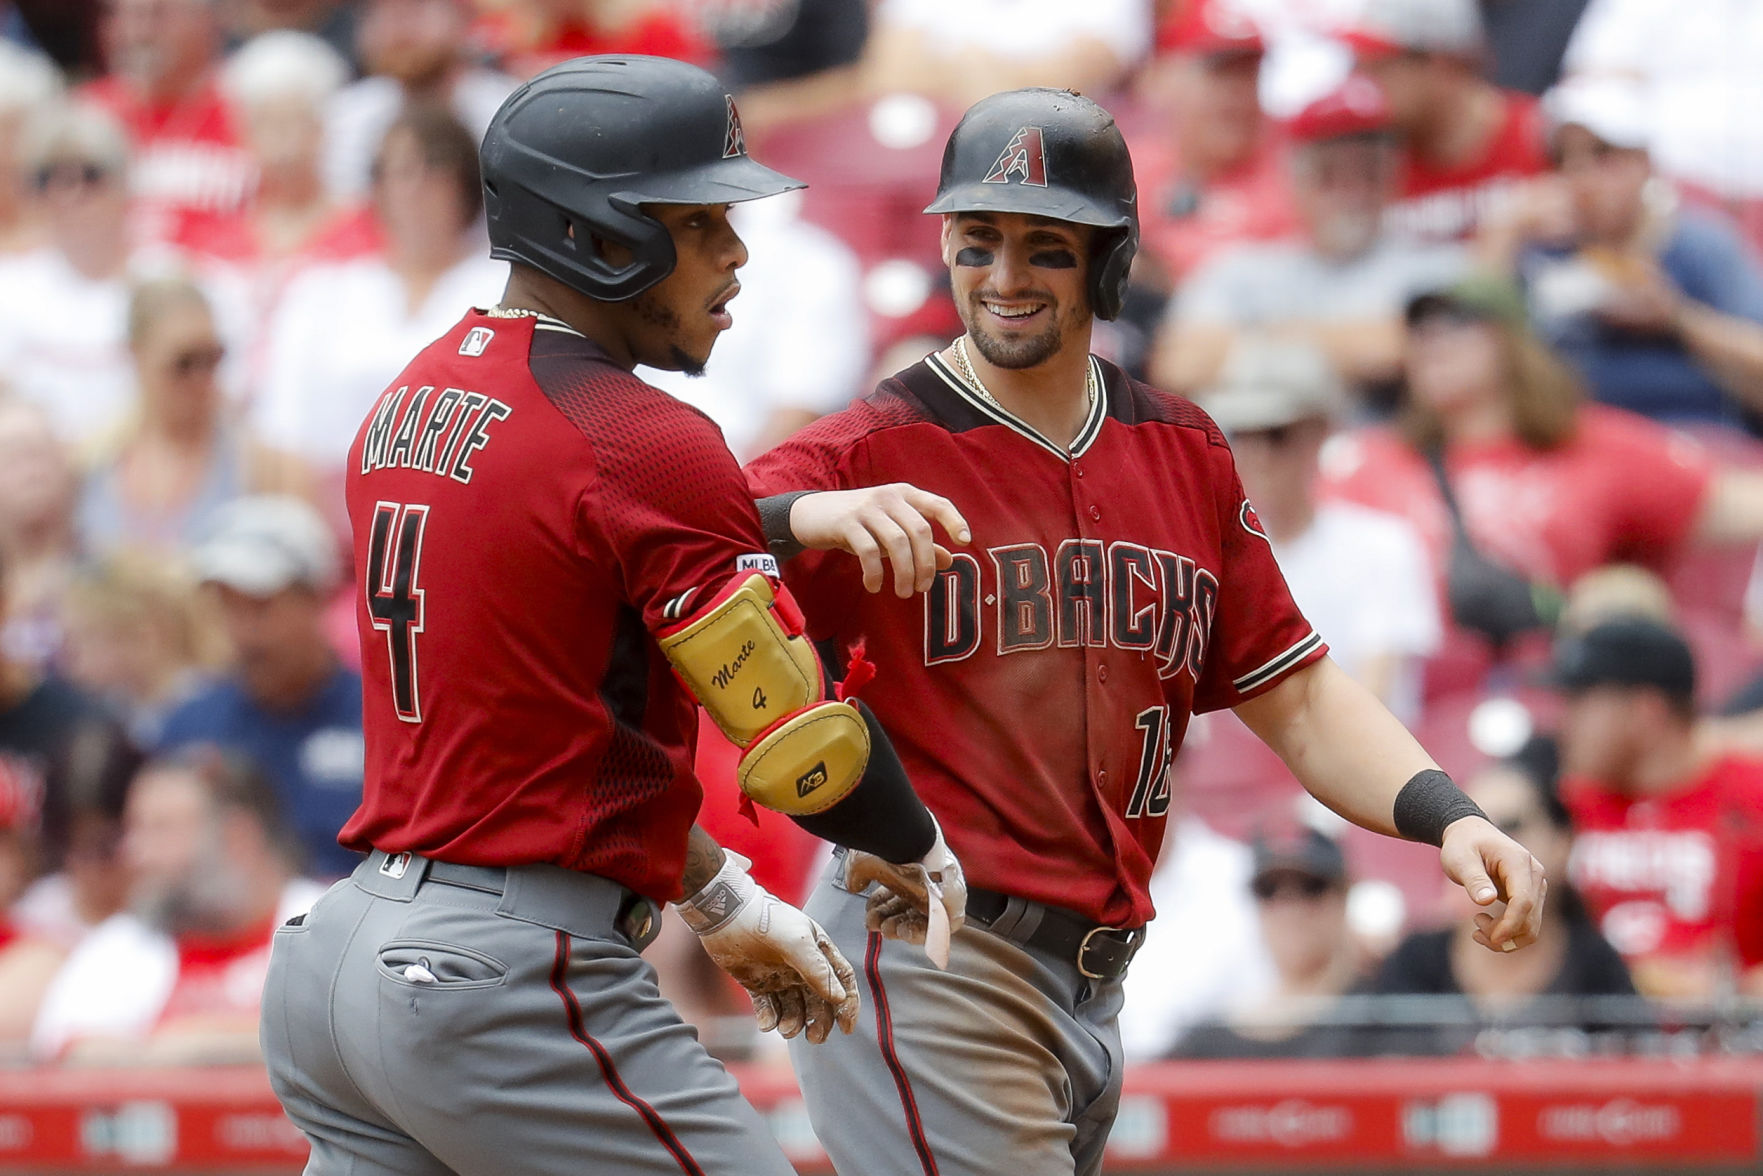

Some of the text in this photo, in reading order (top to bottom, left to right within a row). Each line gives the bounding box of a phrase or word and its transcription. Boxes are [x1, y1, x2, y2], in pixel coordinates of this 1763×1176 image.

[982, 127, 1047, 187] A
[361, 386, 513, 484] MARTE
[366, 501, 430, 723] 4
[711, 640, 755, 689] Marte
[752, 686, 767, 709] 4
